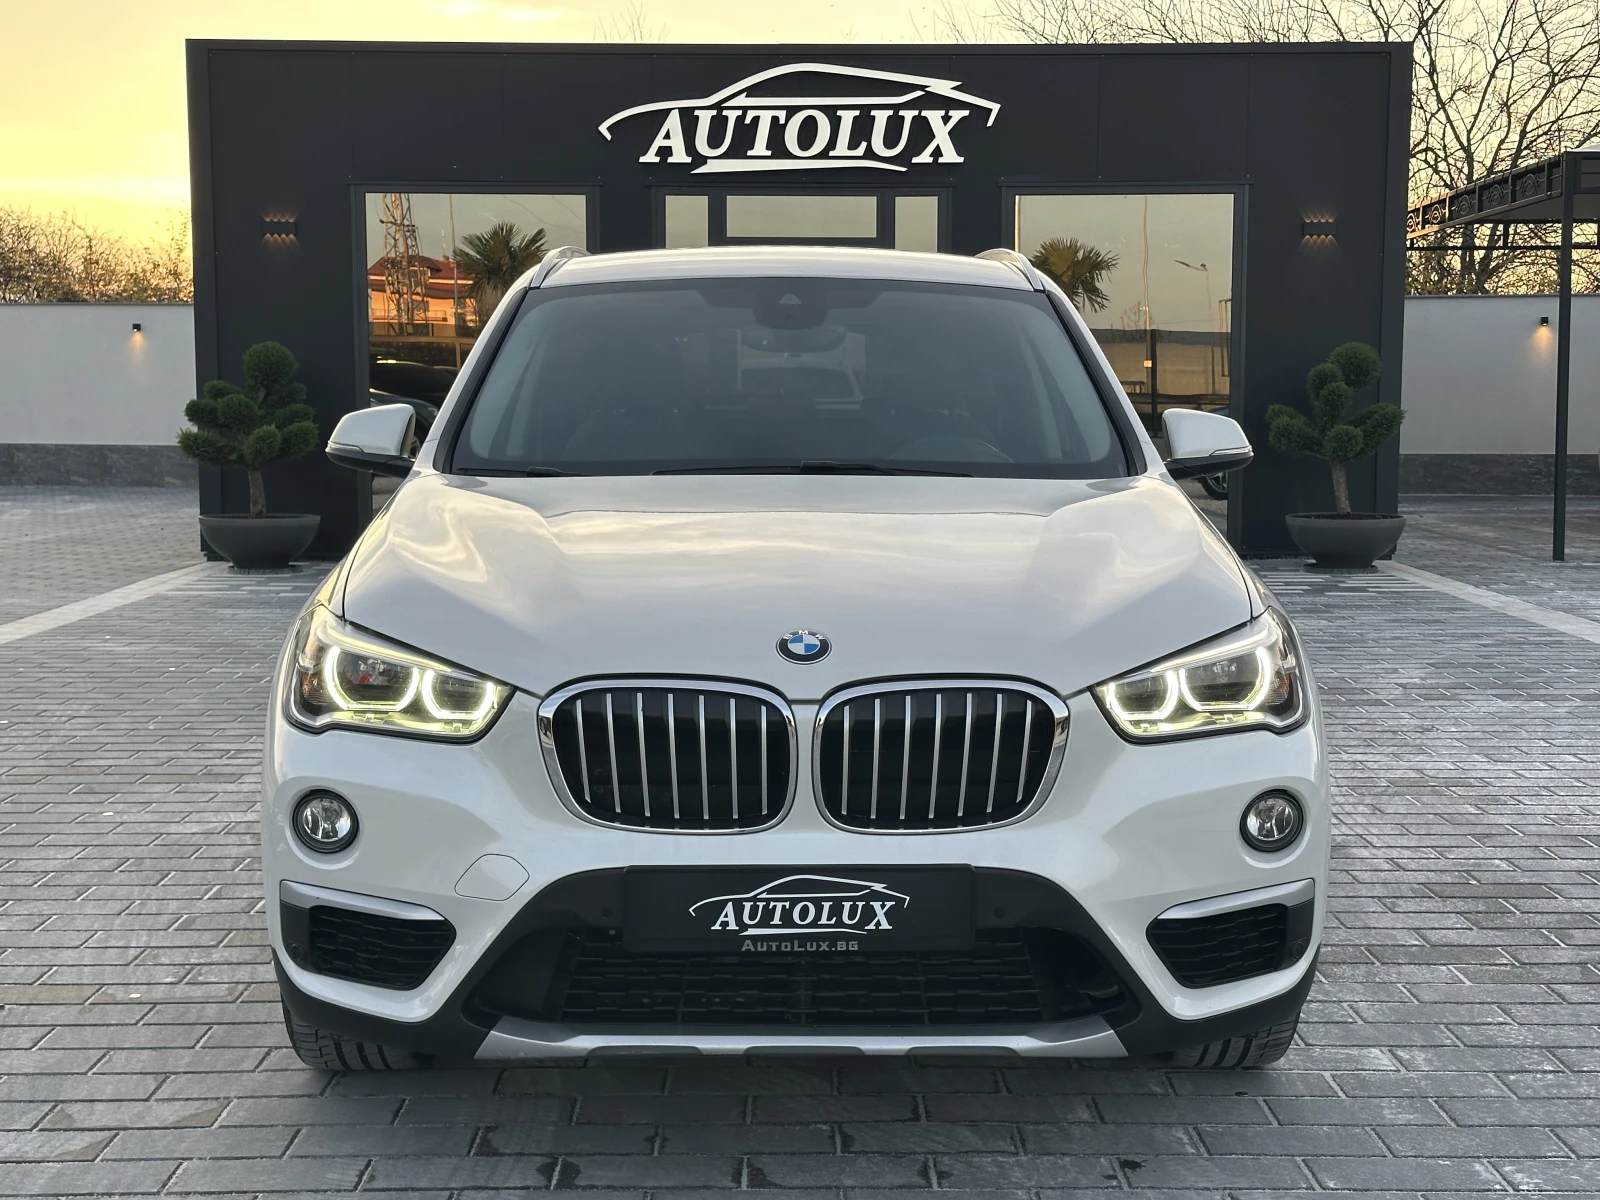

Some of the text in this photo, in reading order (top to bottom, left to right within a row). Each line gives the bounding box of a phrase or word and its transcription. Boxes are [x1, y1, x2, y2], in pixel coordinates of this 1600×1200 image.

[638, 108, 970, 164] AUTOLUX
[782, 629, 826, 640] BMW
[710, 901, 896, 930] AUTOLUX
